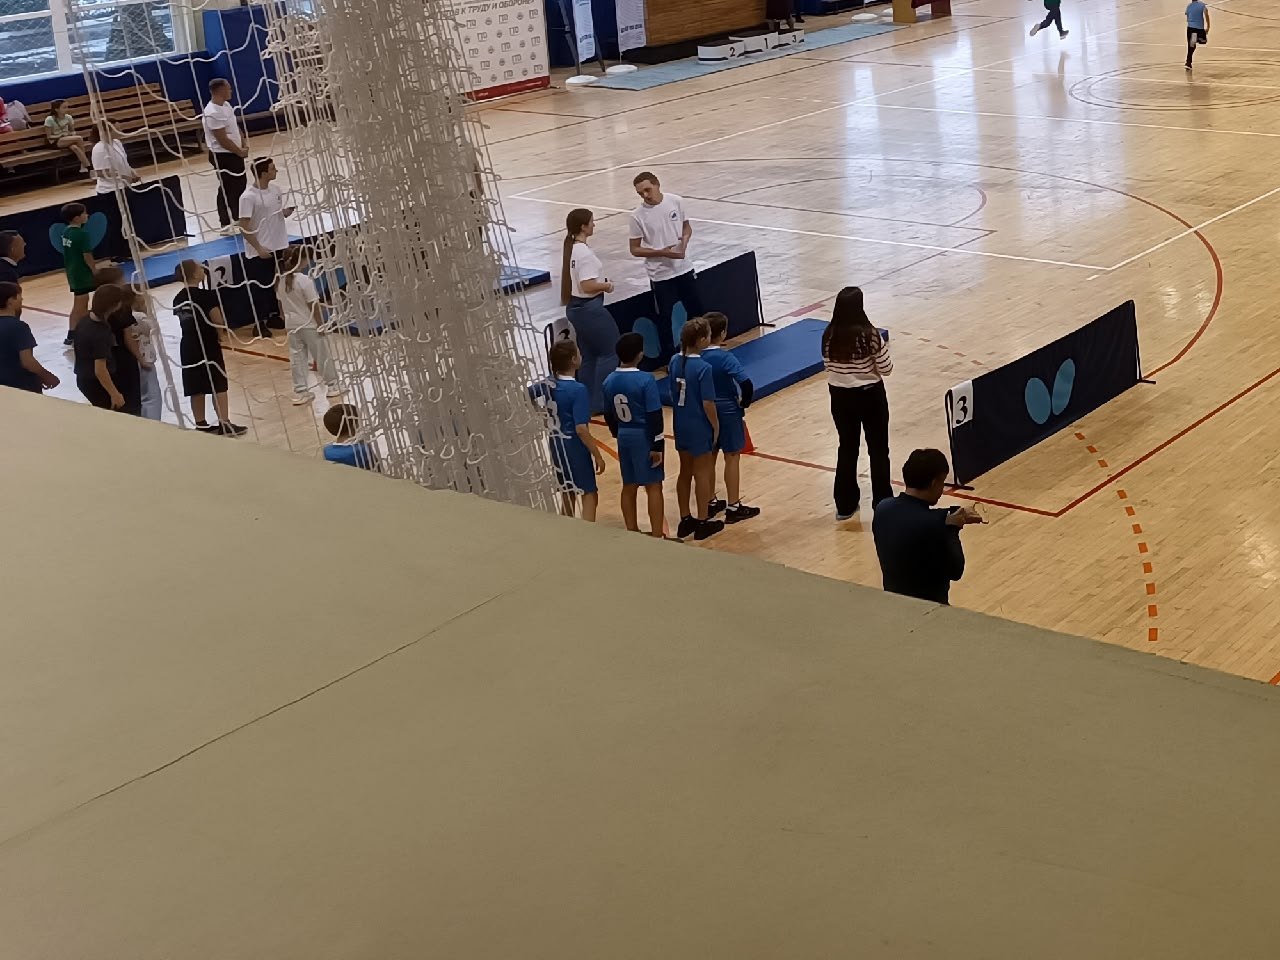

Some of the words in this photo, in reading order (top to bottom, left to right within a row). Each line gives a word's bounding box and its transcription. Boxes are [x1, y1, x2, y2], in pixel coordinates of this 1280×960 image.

[468, 3, 491, 14] ТРУДУ
[492, 2, 498, 10] И
[764, 37, 769, 50] 1
[791, 34, 797, 43] 3
[729, 46, 736, 57] 2
[675, 377, 687, 407] 7
[613, 393, 633, 423] 6
[955, 395, 968, 425] 3
